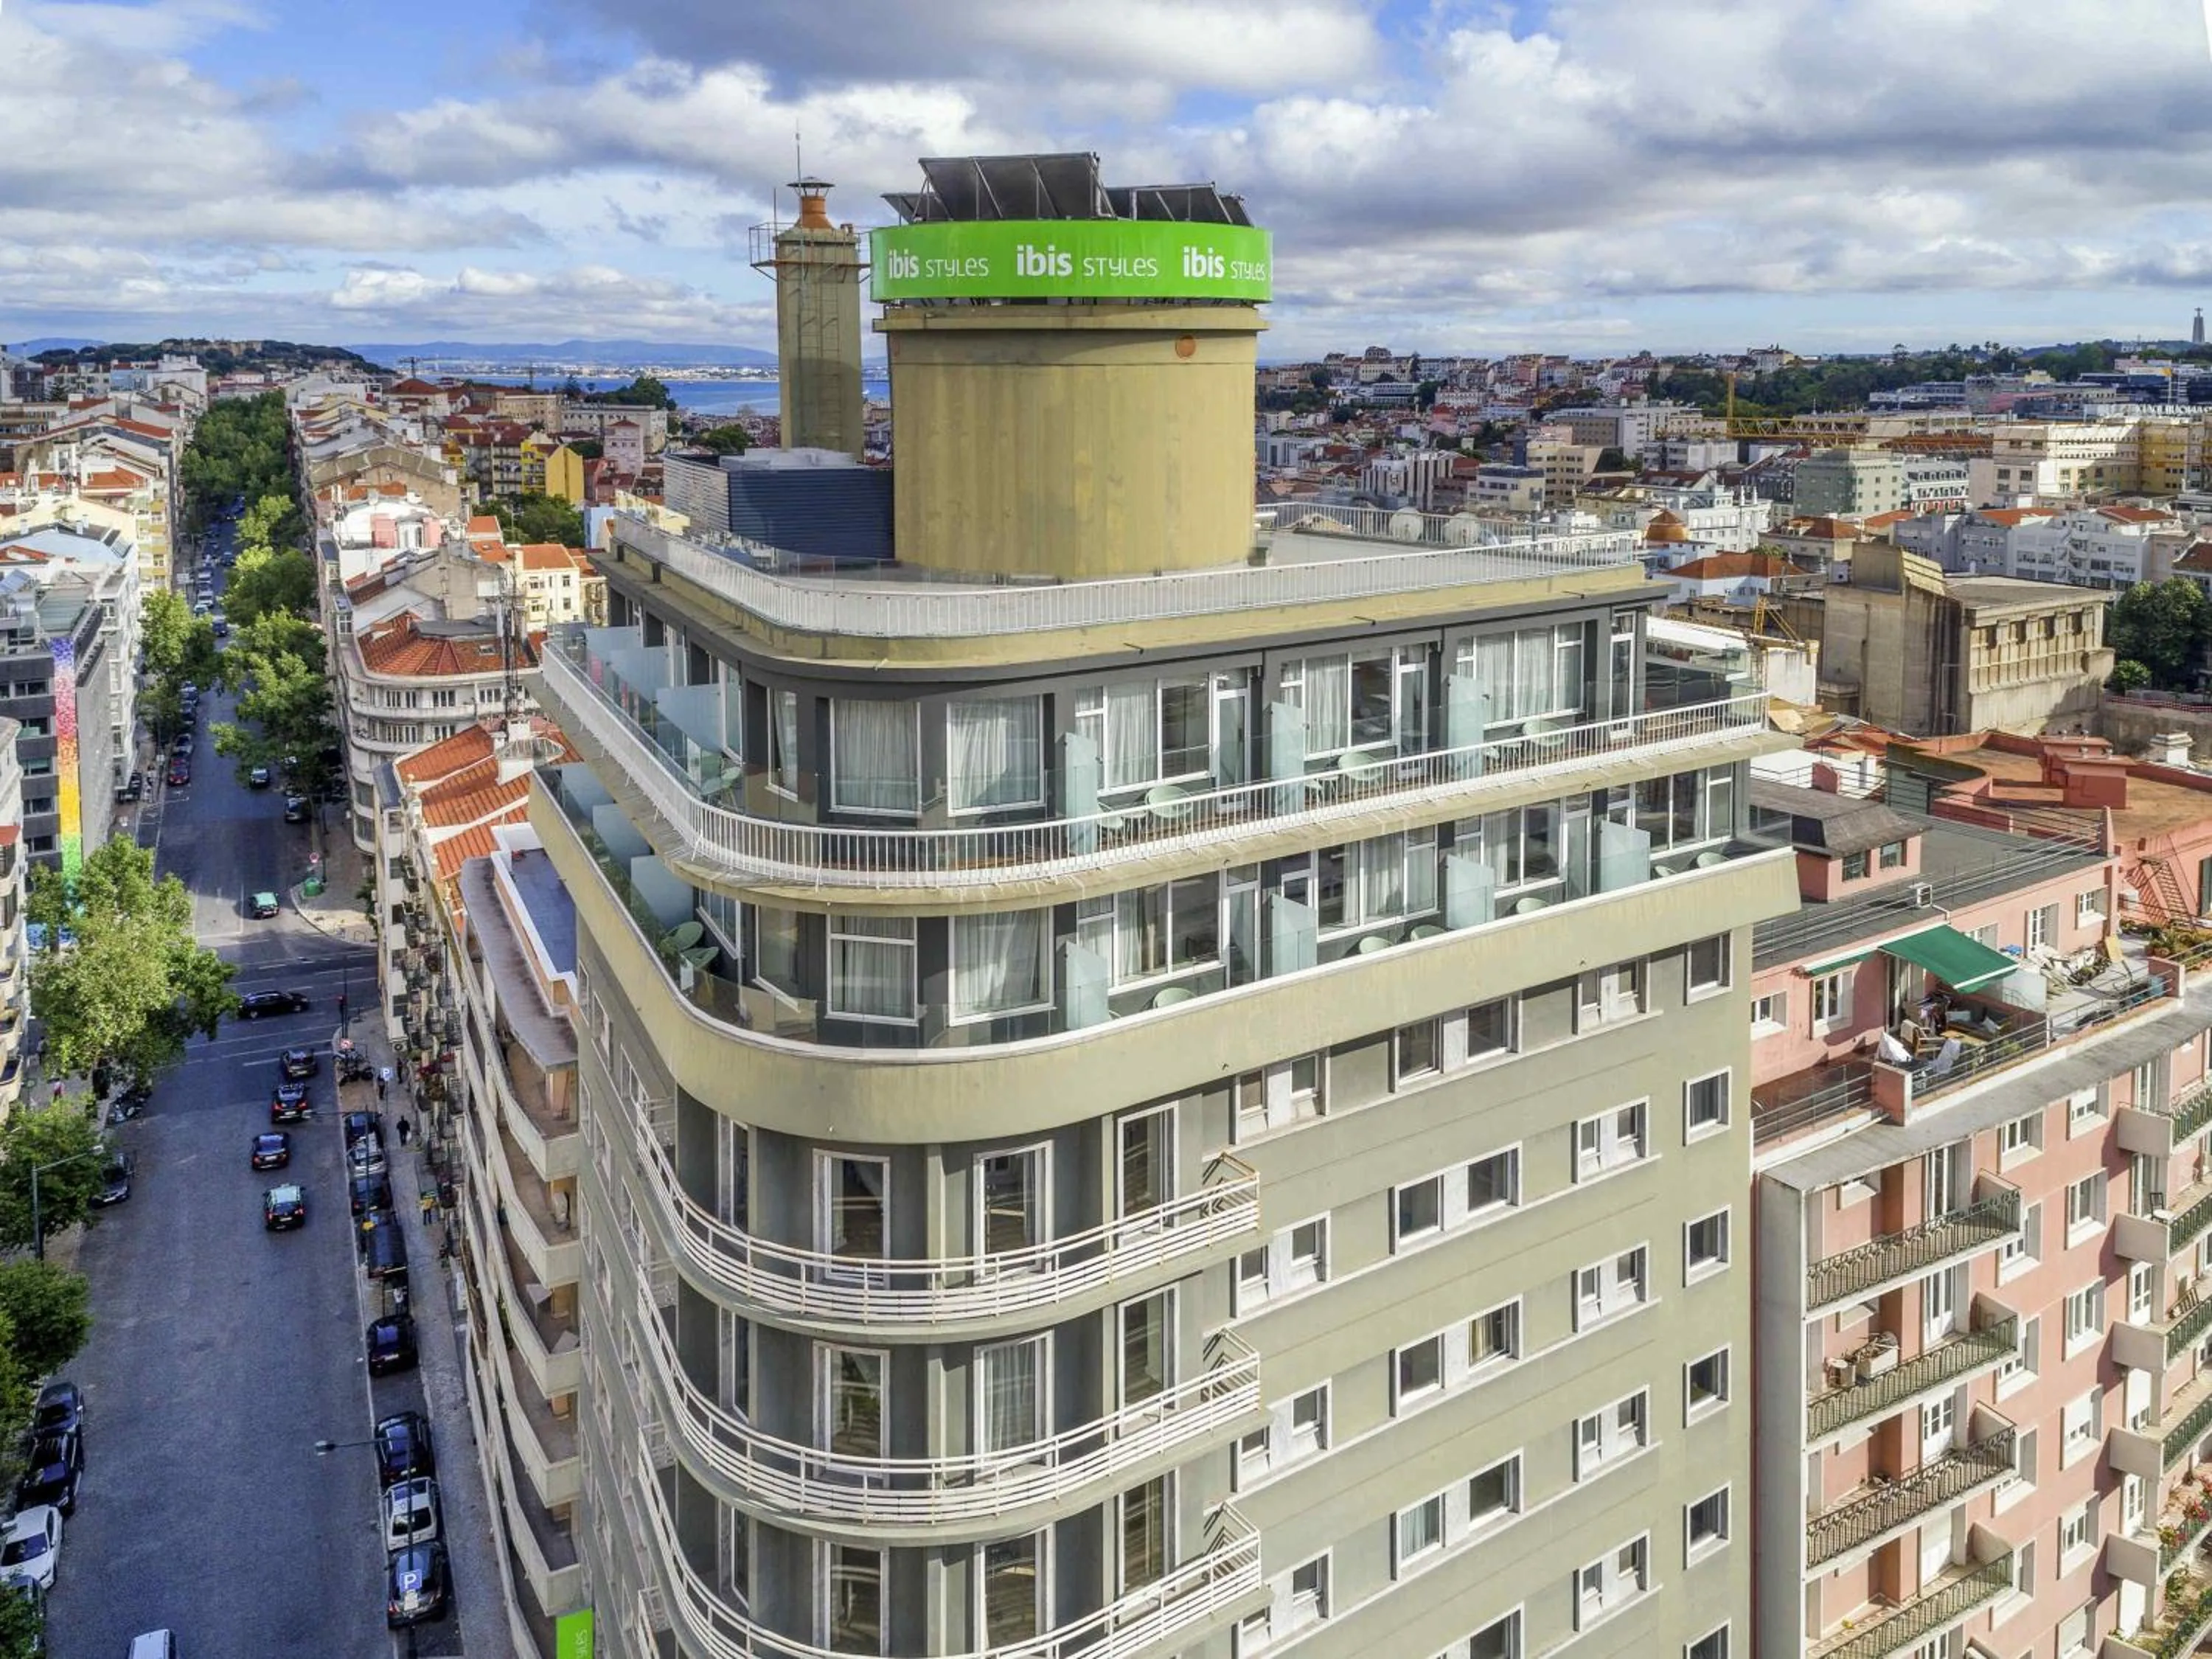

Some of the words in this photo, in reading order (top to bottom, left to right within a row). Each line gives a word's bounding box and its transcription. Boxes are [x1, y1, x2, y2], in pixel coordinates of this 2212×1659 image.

[888, 248, 920, 279] ibis
[1016, 244, 1074, 276] ibis
[1183, 246, 1225, 278] ibis
[404, 1573, 417, 1589] P
